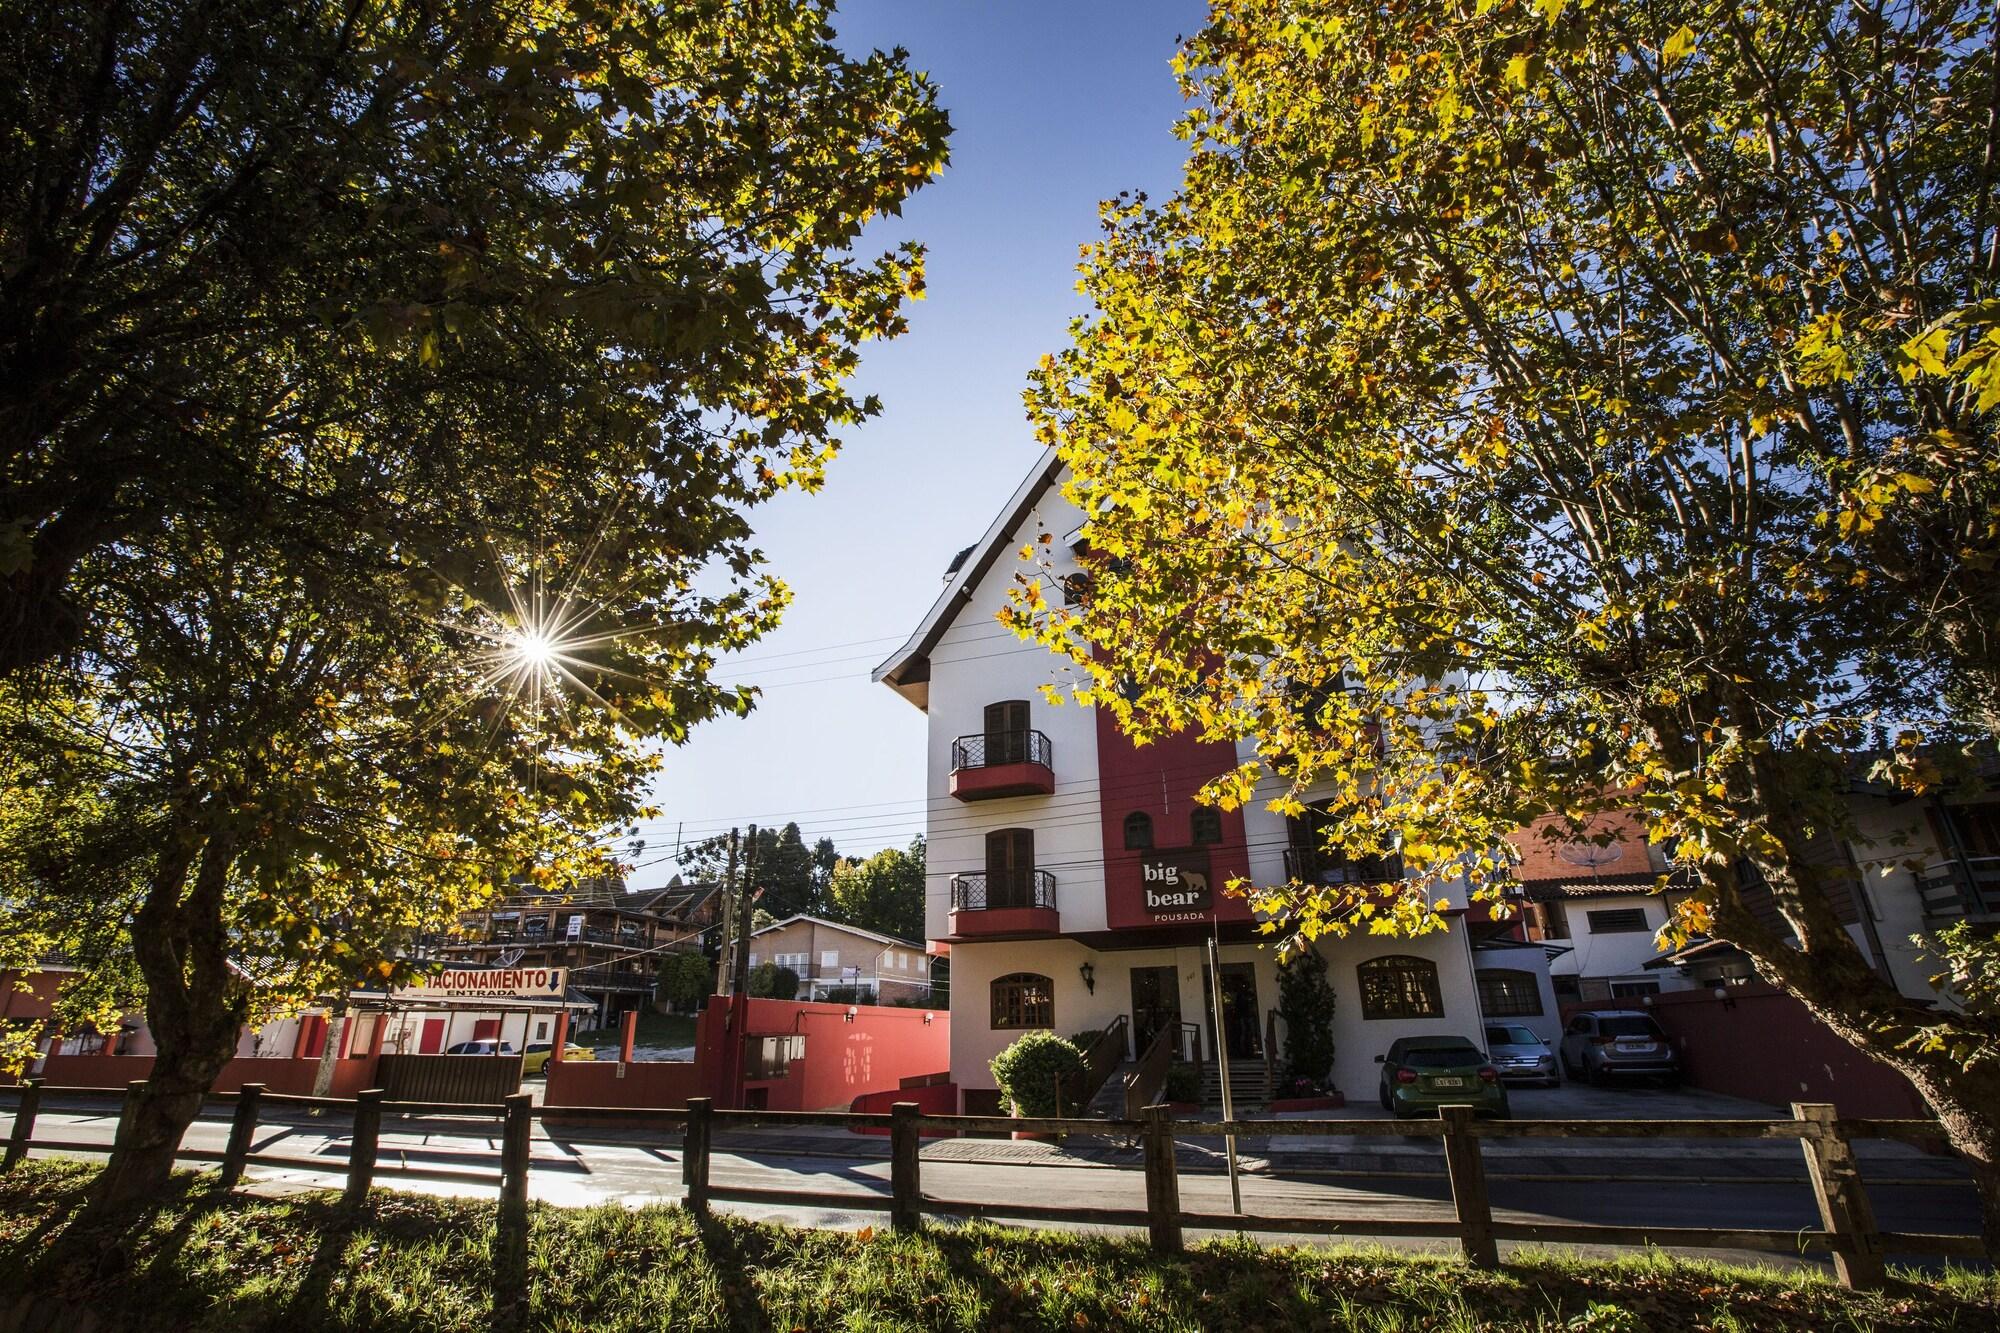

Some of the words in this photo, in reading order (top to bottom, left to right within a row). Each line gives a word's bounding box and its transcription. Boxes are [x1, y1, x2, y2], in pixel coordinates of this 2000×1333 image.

[1143, 862, 1179, 885] big
[1146, 890, 1199, 907] bear
[1154, 913, 1205, 921] POUSADA
[409, 969, 547, 989] TACIONAMENTO
